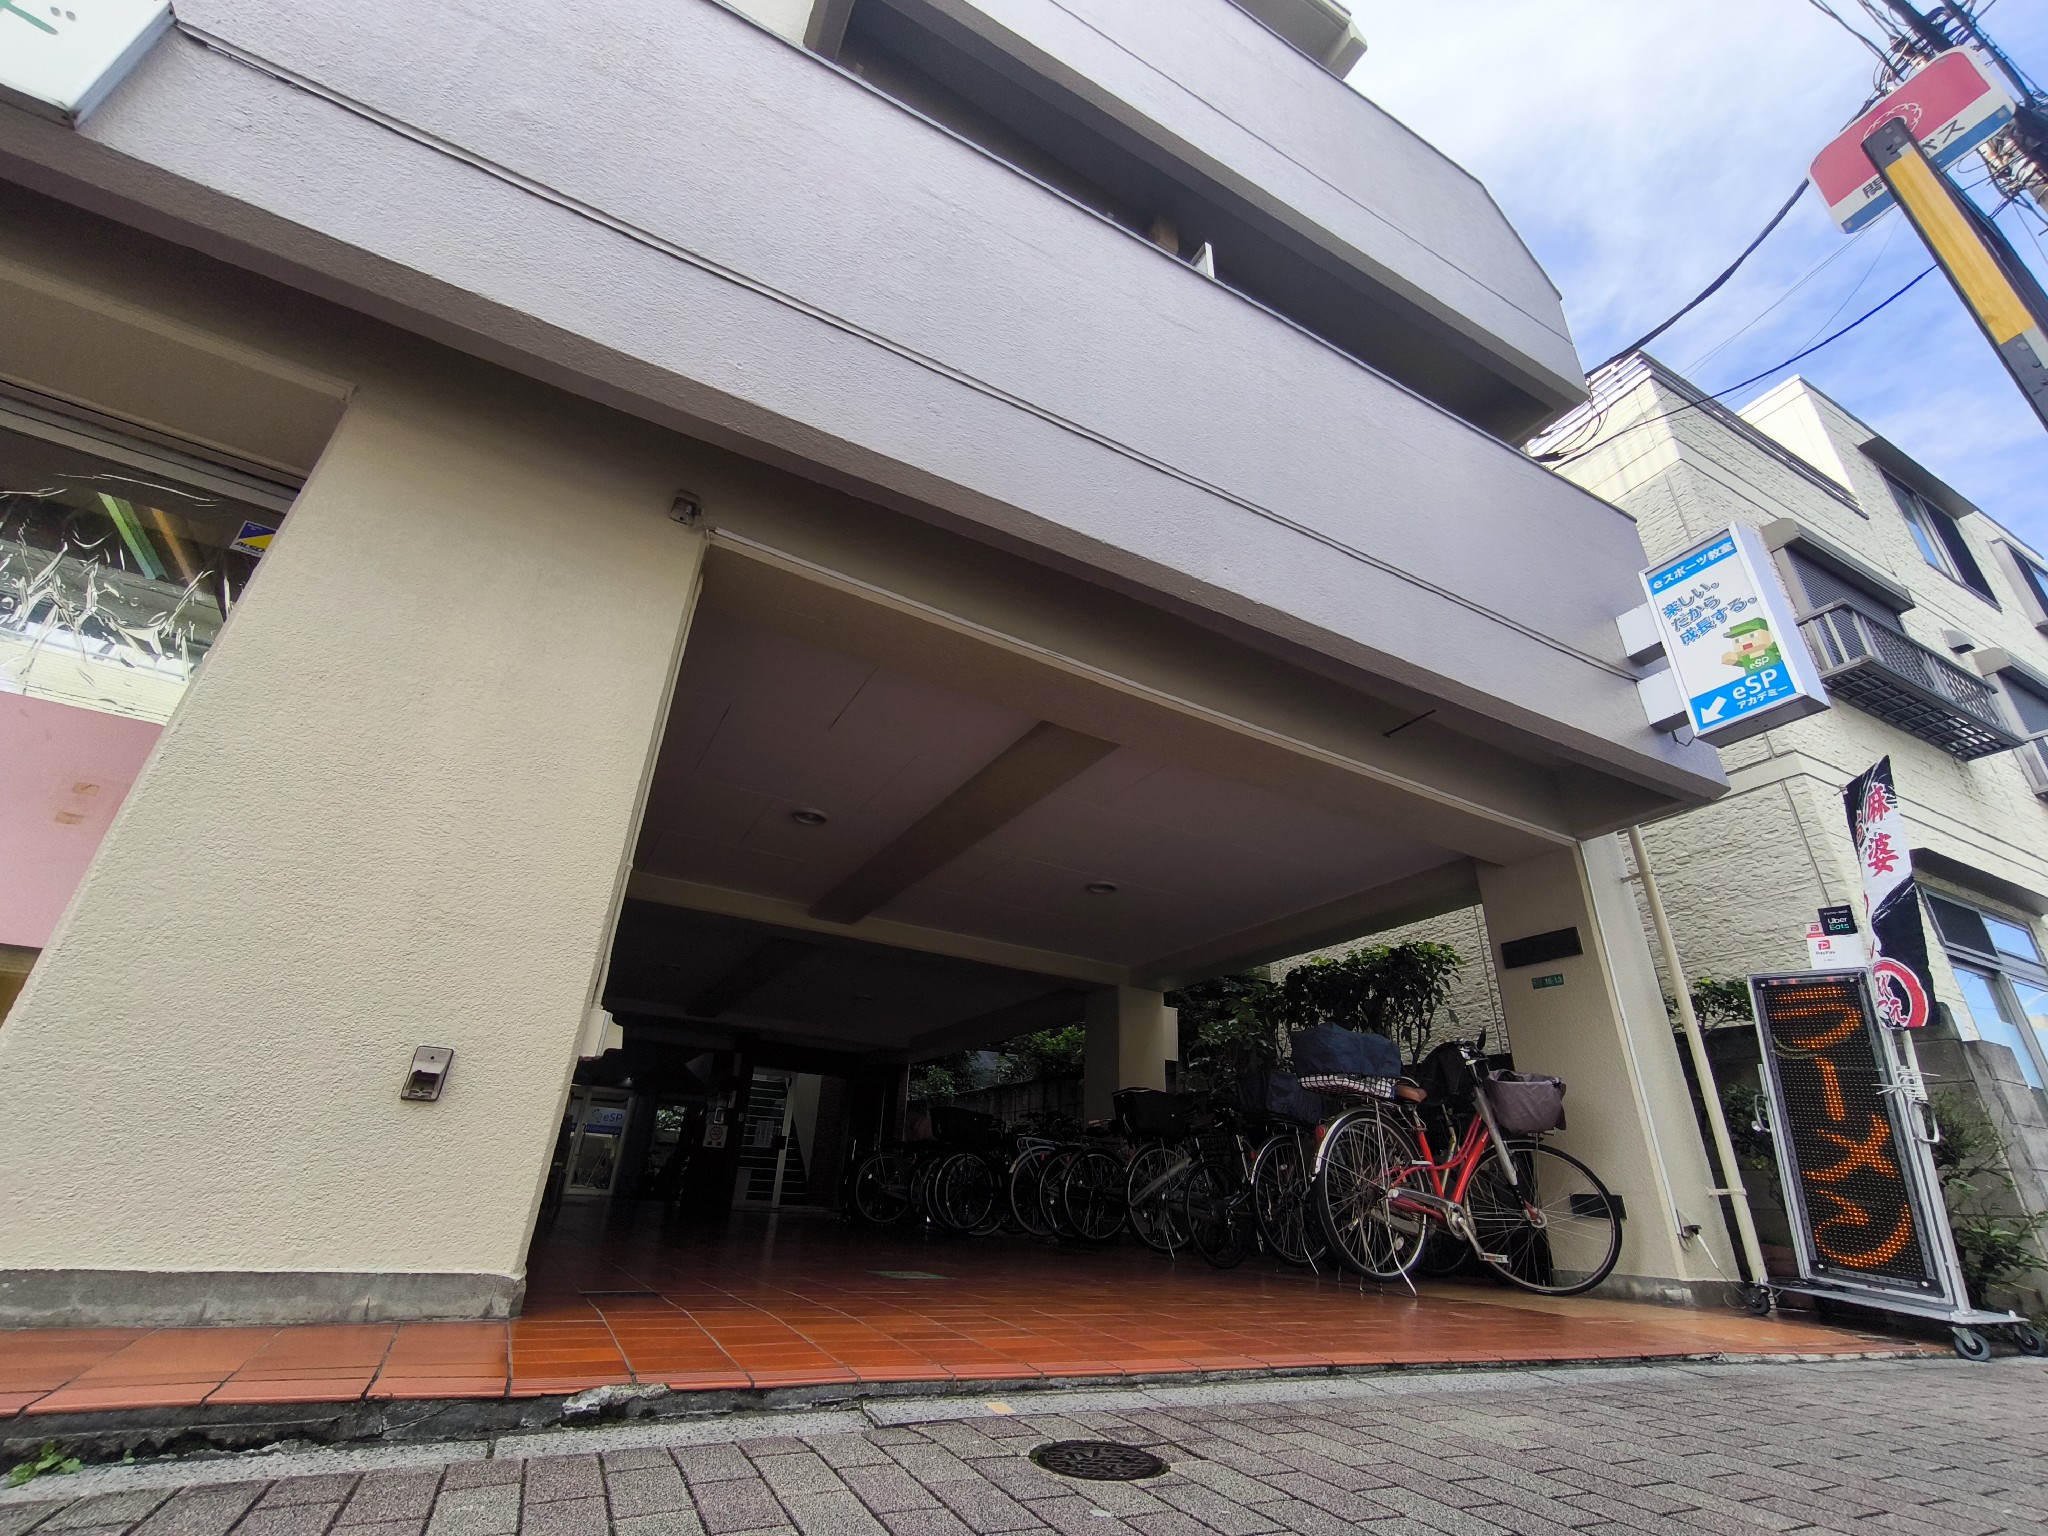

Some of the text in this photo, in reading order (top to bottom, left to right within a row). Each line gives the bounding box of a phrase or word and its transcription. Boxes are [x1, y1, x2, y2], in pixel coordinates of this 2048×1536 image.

[1653, 541, 1735, 590] eスポーツ教室
[1662, 581, 1720, 619] 楽しい。
[1671, 596, 1721, 632] だから
[1679, 596, 1758, 646] 成長する。
[1749, 657, 1769, 669] eSP
[1732, 669, 1778, 700] eSP
[1737, 686, 1789, 710] アカデミー
[603, 1113, 623, 1122] eSP
[1770, 985, 1911, 1270] ラーメン
